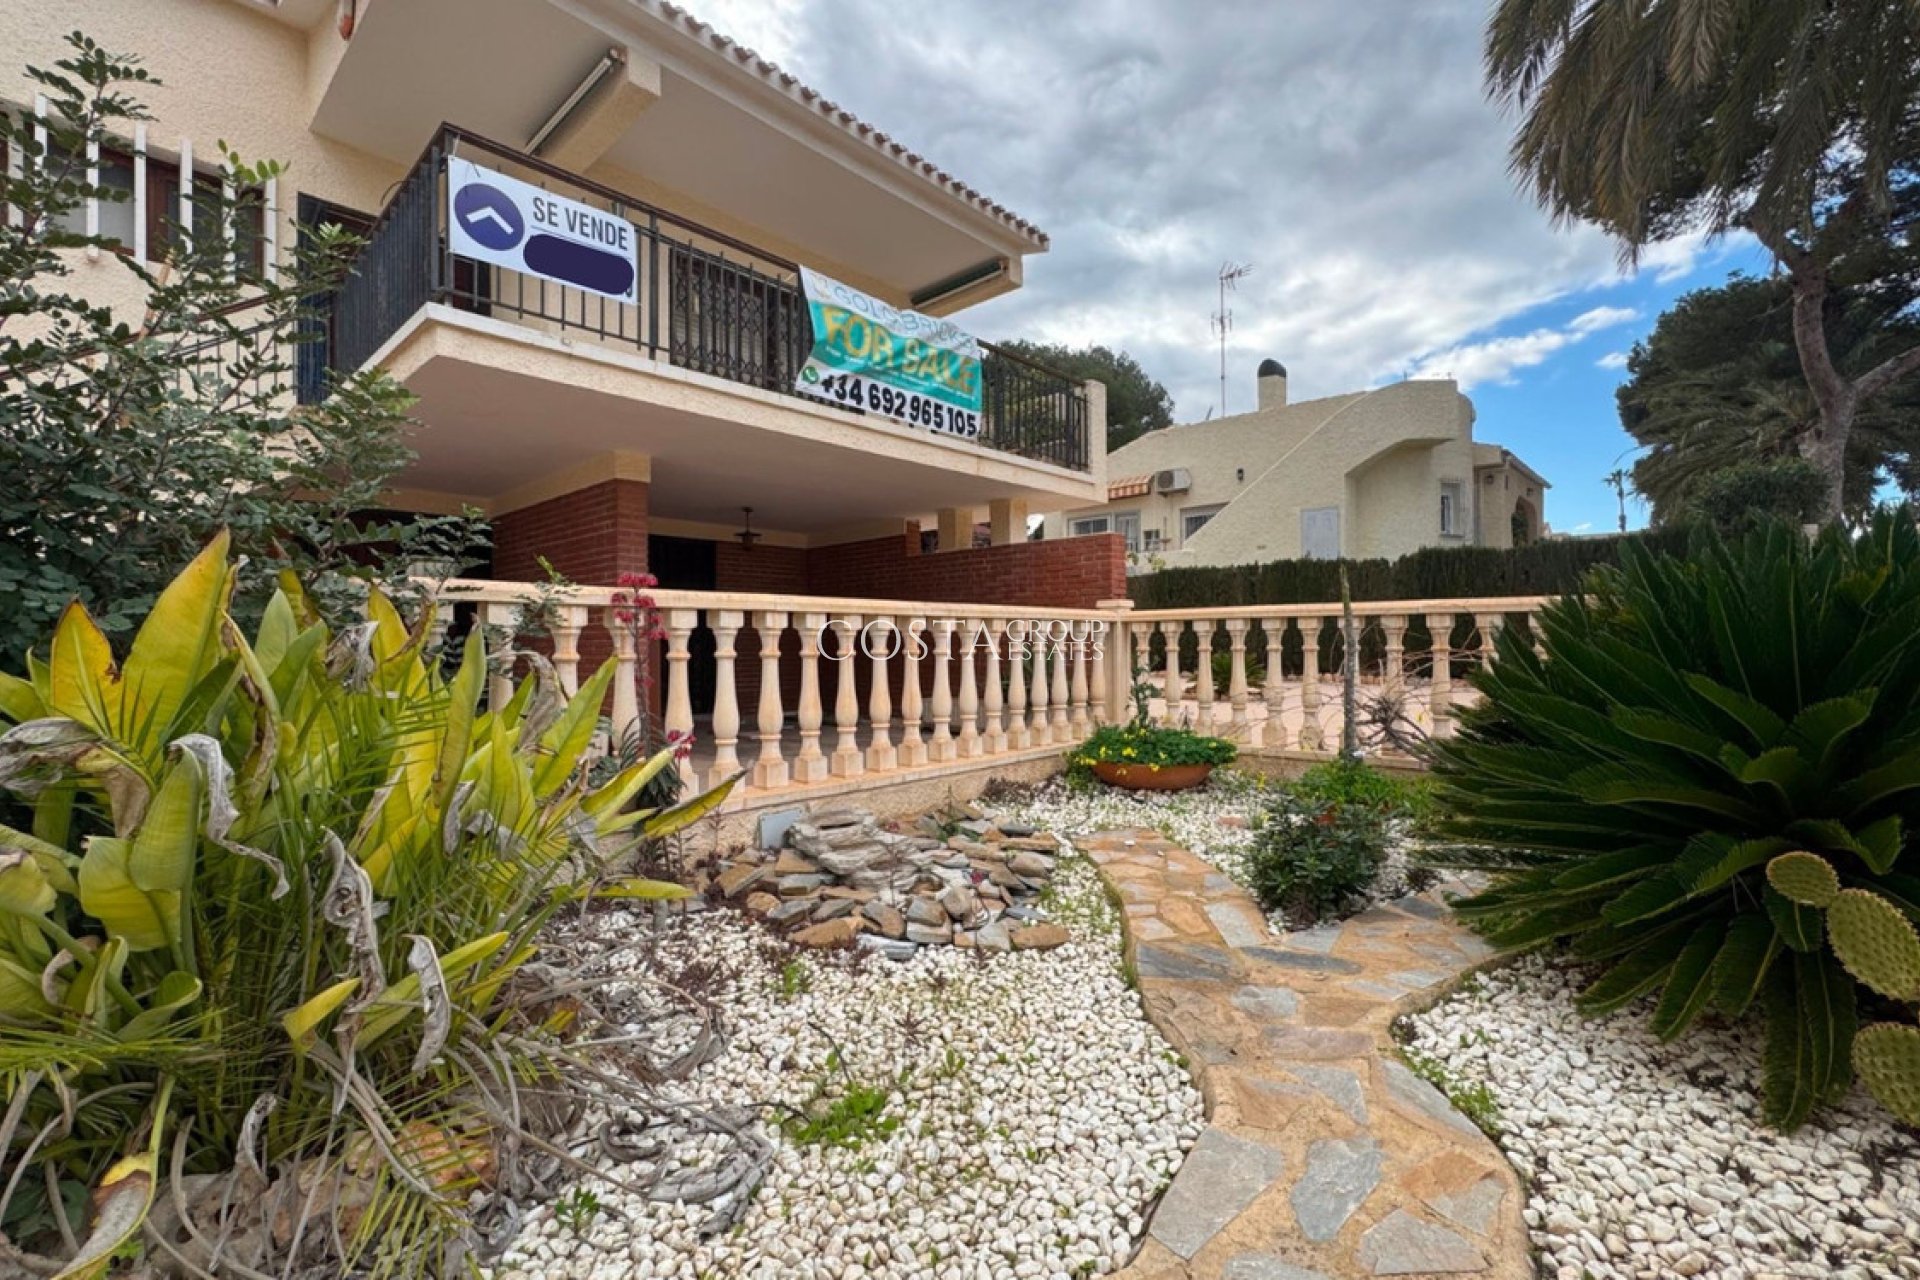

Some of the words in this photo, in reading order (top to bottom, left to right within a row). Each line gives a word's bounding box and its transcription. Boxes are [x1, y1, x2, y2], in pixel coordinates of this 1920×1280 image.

[532, 197, 559, 227] SE
[564, 207, 628, 250] VENDE
[822, 307, 893, 367] FOR
[902, 338, 975, 394] SALE
[821, 374, 863, 405] +34
